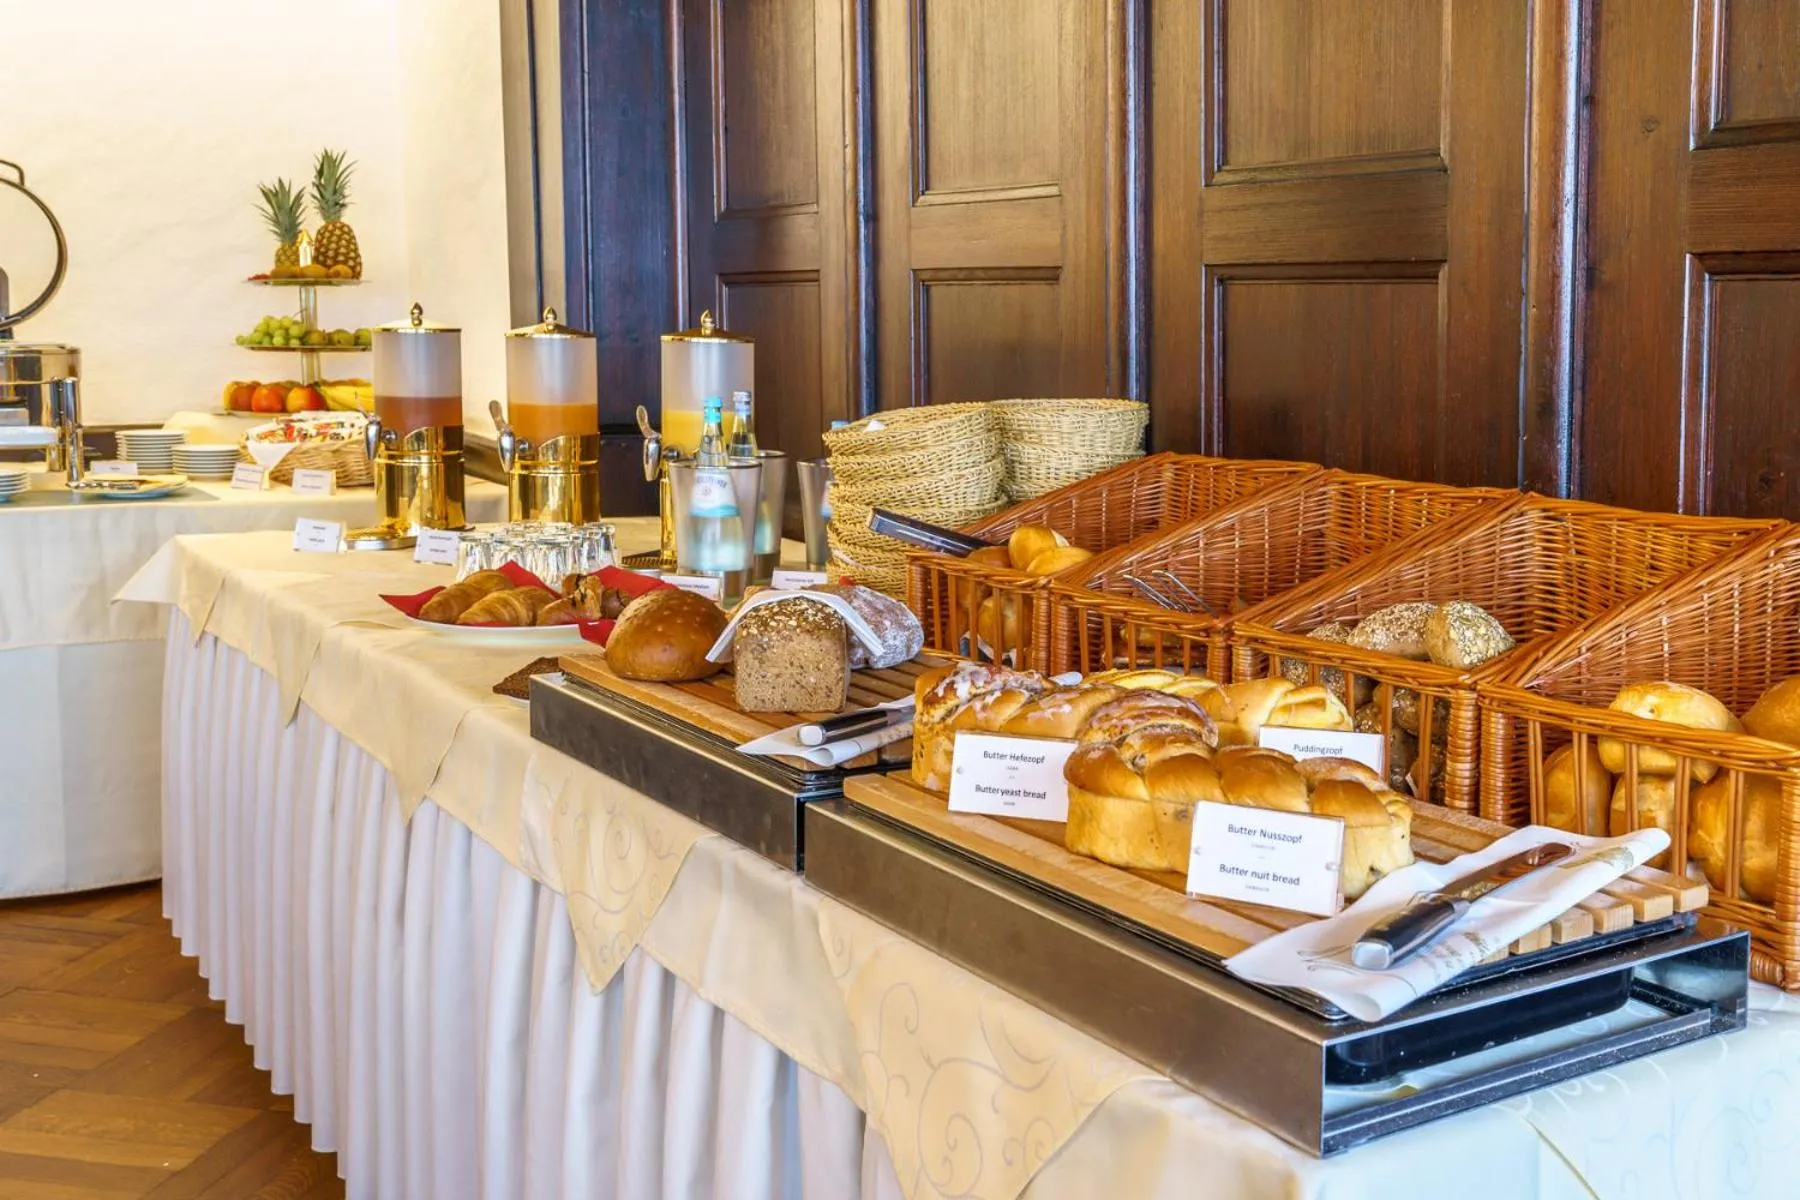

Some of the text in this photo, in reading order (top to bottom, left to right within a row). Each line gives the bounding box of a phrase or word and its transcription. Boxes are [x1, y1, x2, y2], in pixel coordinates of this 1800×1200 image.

[1293, 743, 1343, 756] Puddingzopf
[983, 750, 1046, 765] Butter Hefezopf
[1023, 790, 1047, 800] bread
[1228, 823, 1303, 844] Butter Nusszopf
[1219, 863, 1300, 886] Butter nuit bread
